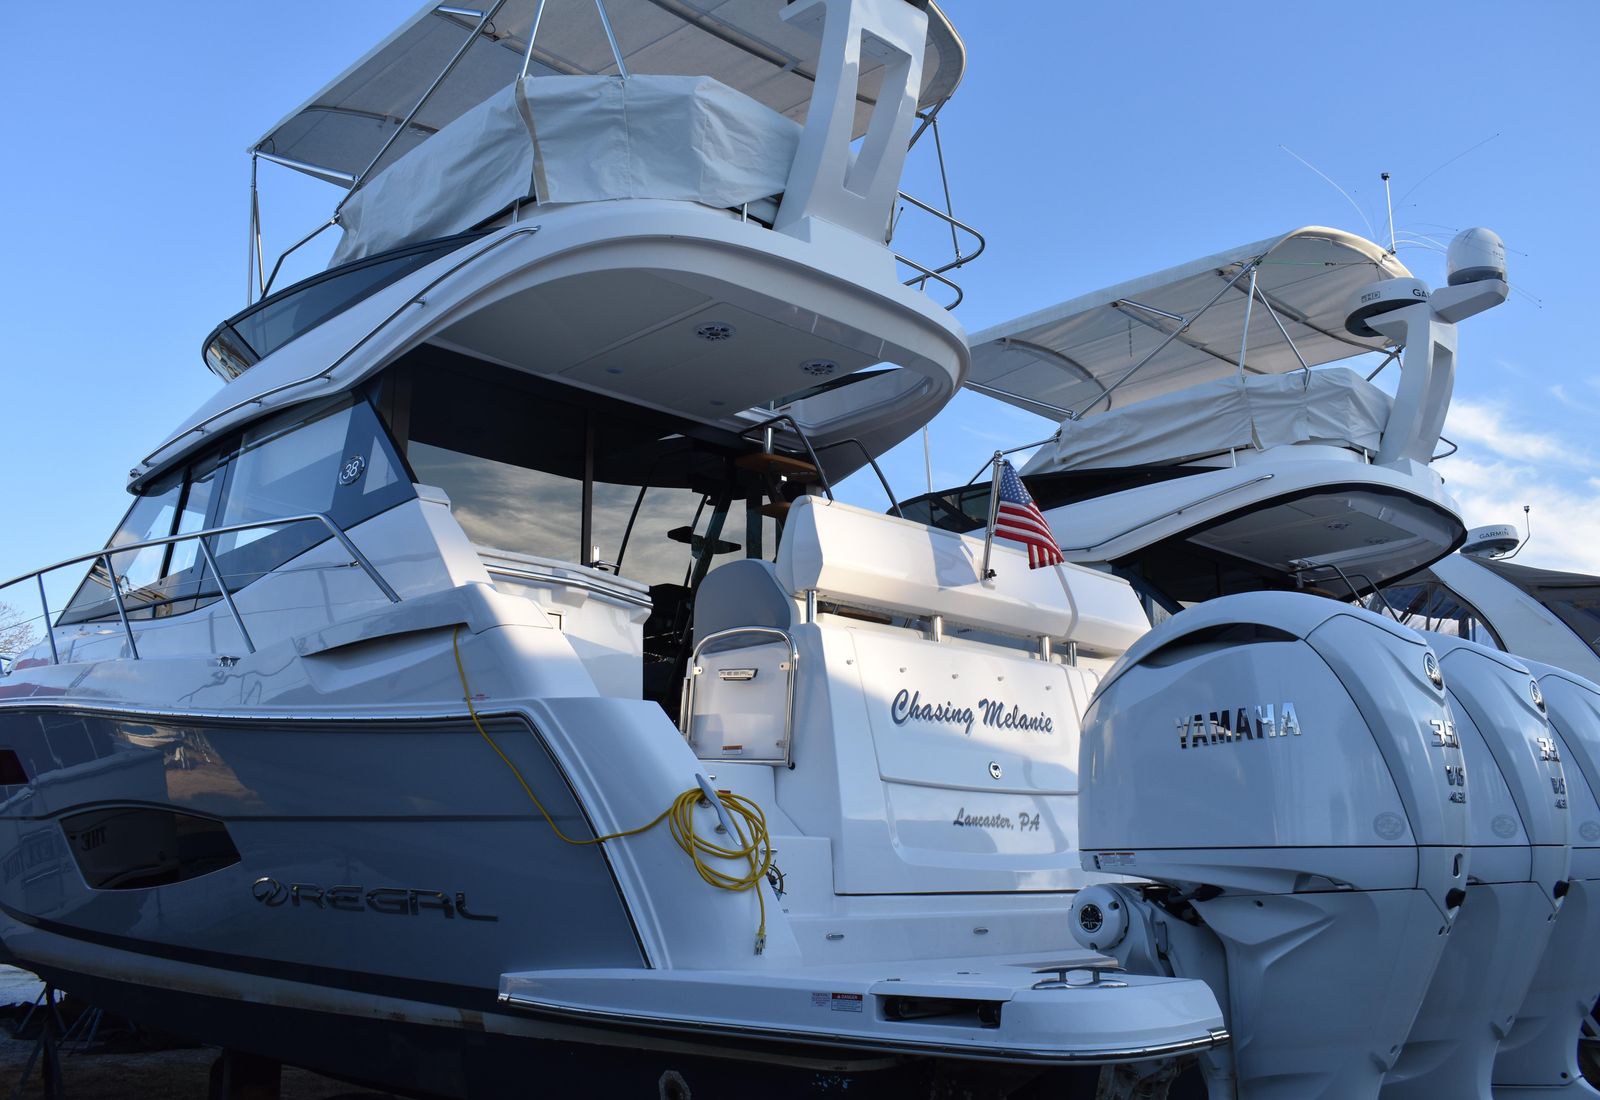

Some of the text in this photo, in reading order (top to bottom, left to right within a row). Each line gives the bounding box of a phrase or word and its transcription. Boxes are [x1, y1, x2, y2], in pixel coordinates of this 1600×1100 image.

[343, 461, 359, 479] 38
[1479, 531, 1509, 539] GARMIN
[891, 689, 1053, 734] Chasing Melanie
[1174, 702, 1302, 749] YAMAHA
[1445, 765, 1464, 786] V6
[953, 807, 1040, 832] Lancaster, PA
[291, 883, 498, 922] REGAL
